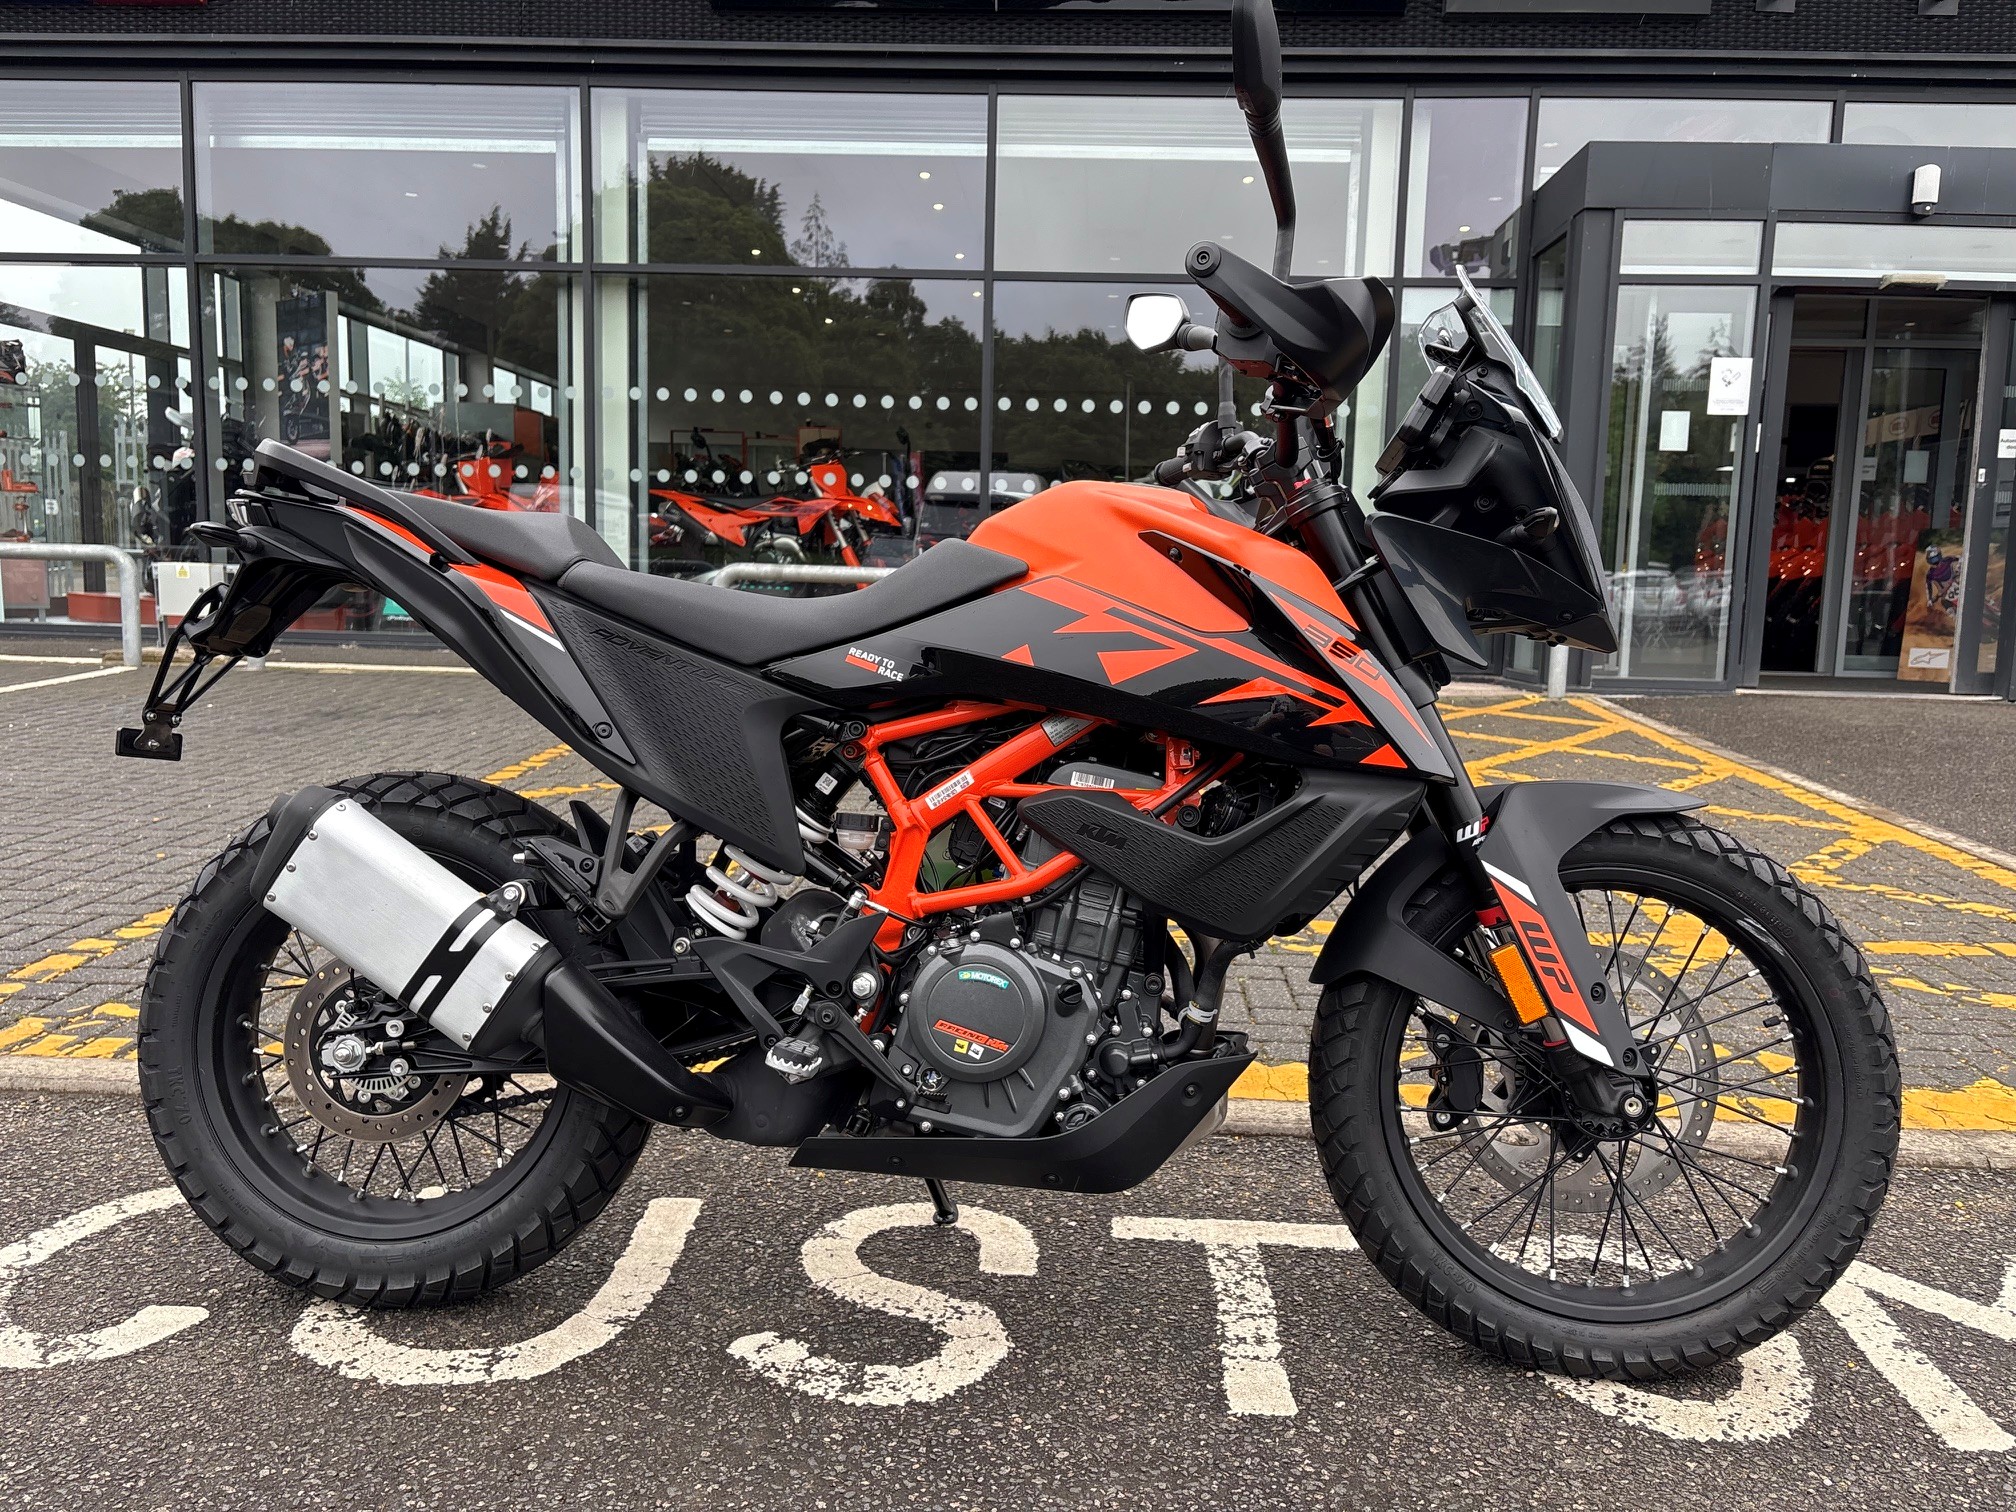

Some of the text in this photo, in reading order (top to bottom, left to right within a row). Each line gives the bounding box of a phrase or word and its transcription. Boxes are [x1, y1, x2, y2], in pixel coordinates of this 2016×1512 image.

[588, 628, 755, 696] ADVENTURE
[848, 647, 895, 669] READY TO
[1303, 623, 1380, 681] 390
[877, 665, 904, 682] RACE
[1076, 822, 1128, 851] KTM
[1456, 816, 1489, 843] WP
[1518, 920, 1574, 994] WP
[971, 971, 1005, 988] MOTOREX
[939, 1022, 985, 1043] RACING
